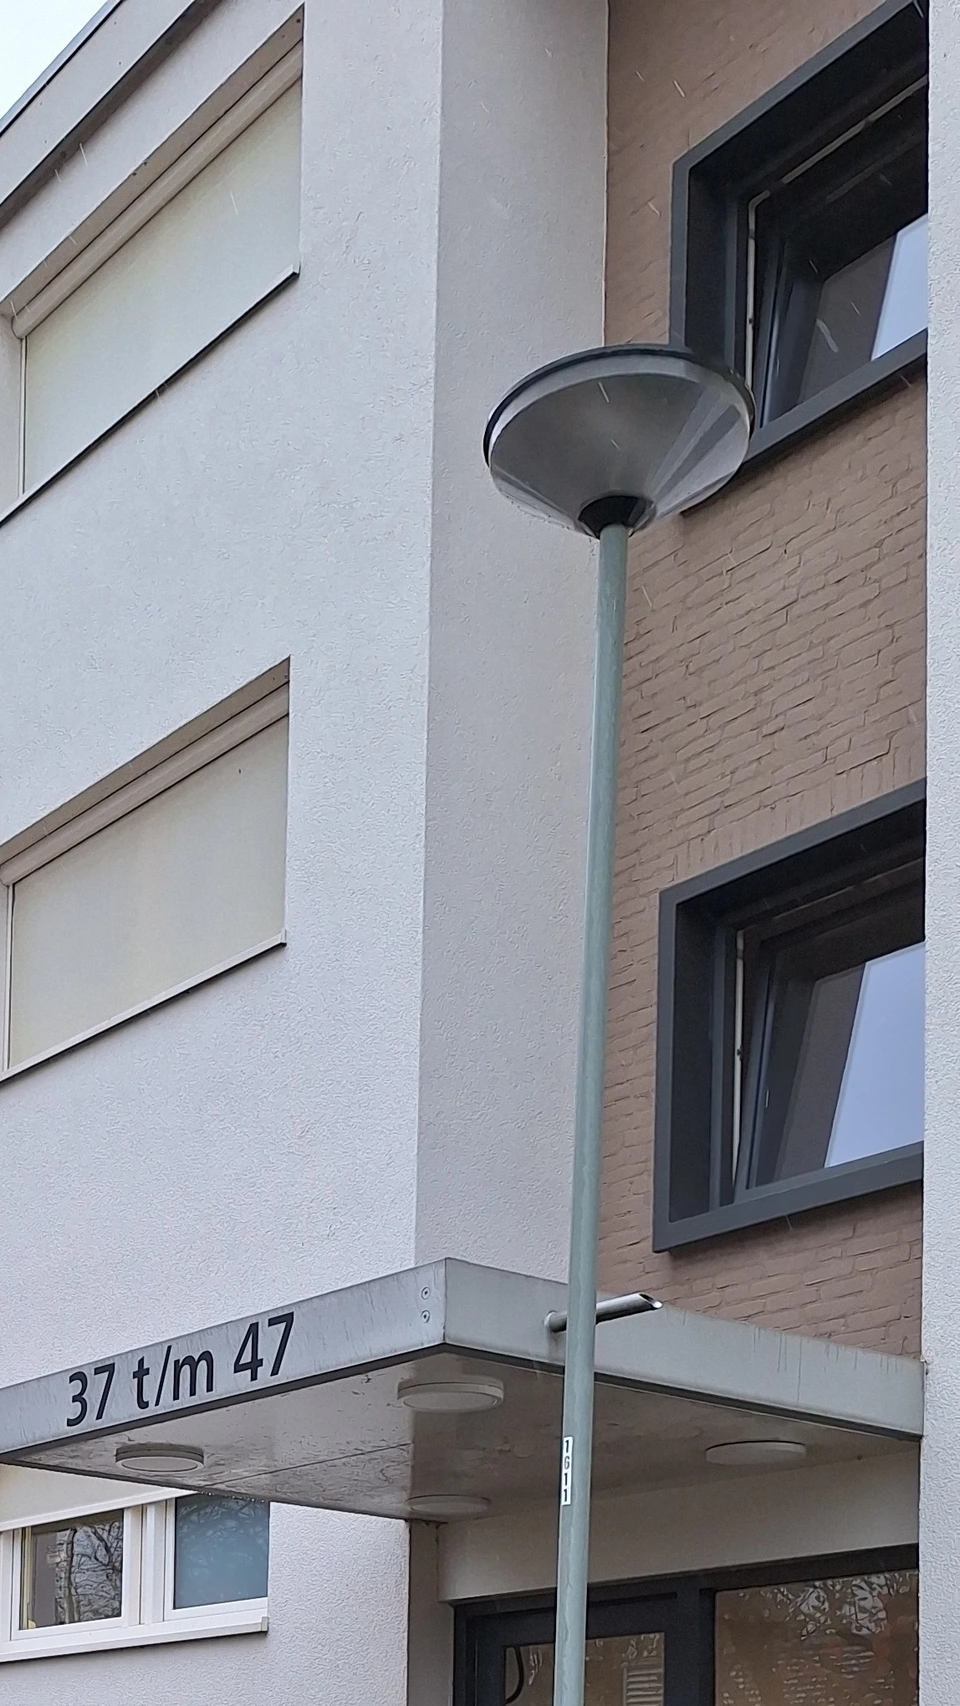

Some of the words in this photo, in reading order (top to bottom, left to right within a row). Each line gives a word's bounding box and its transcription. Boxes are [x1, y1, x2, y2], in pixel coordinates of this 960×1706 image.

[66, 1362, 115, 1428] 37
[131, 1345, 215, 1411] t/m
[232, 1311, 296, 1382] 47
[563, 1439, 571, 1503] 1611
